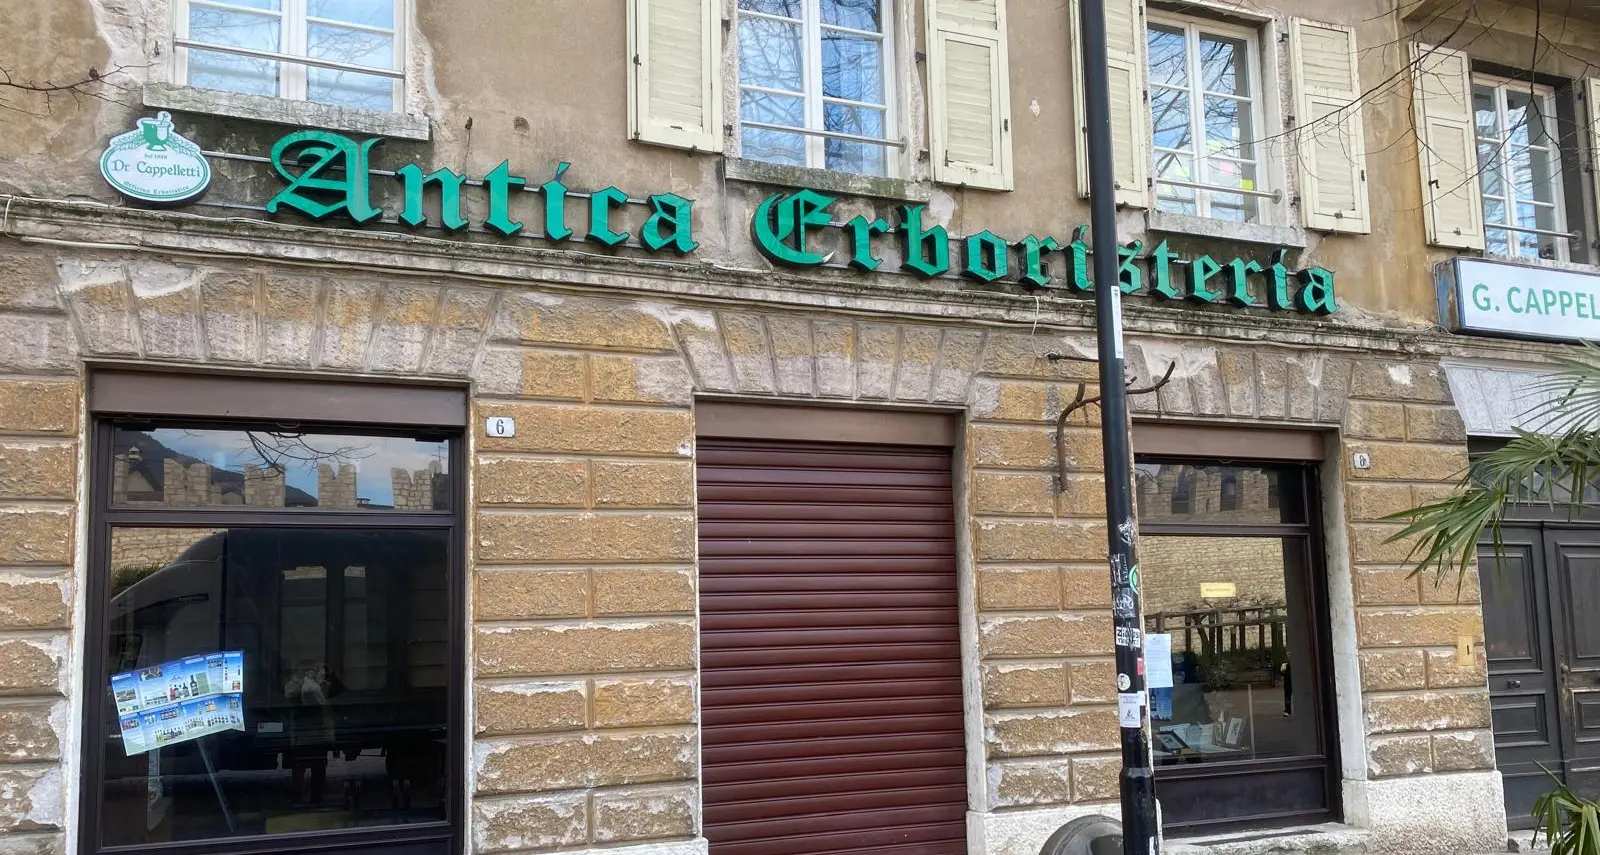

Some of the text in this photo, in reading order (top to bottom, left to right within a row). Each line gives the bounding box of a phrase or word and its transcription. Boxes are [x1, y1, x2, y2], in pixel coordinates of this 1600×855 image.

[136, 161, 200, 177] Cappelletti
[265, 130, 1337, 316] Antica Erboristeria
[1472, 283, 1600, 320] G. CAPPEL
[495, 418, 505, 435] 6
